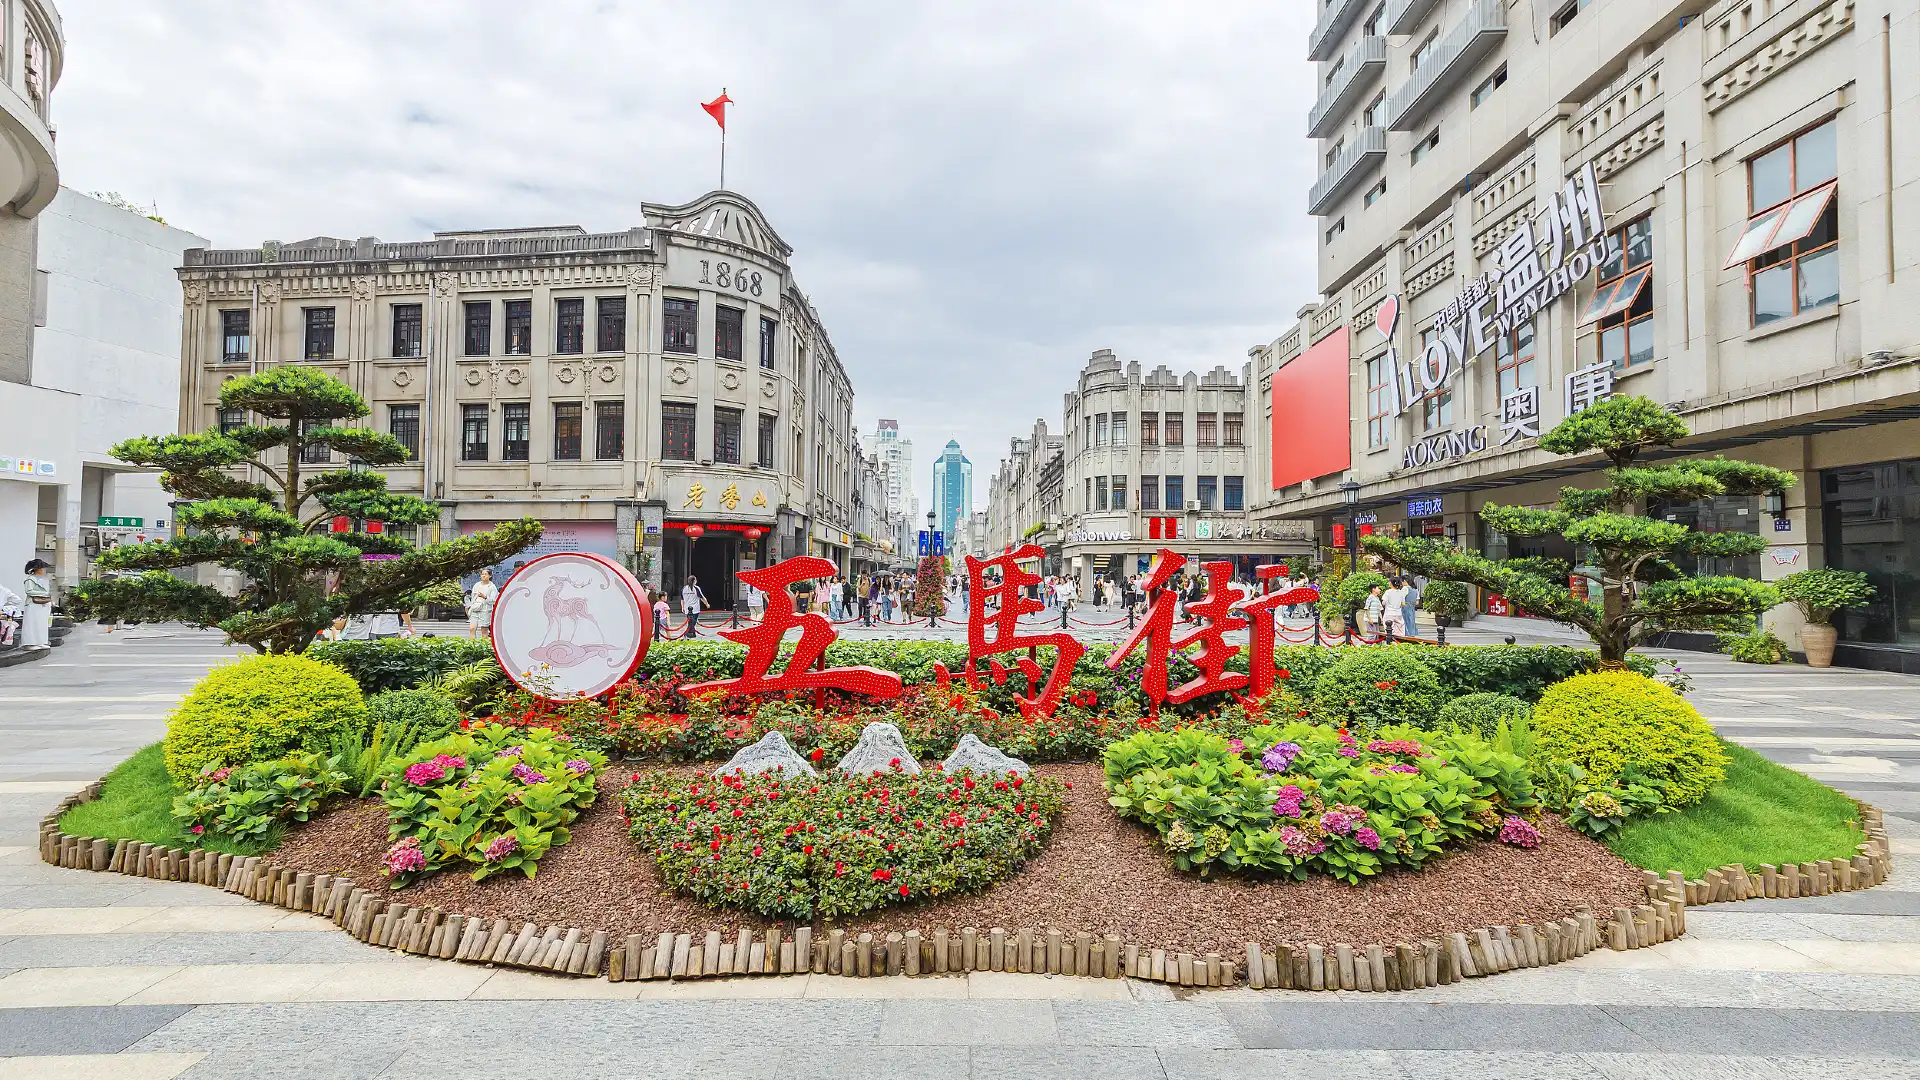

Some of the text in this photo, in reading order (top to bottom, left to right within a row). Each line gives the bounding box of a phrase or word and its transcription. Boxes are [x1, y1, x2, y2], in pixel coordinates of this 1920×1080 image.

[699, 260, 763, 297] 1868
[1492, 161, 1606, 314] 温州
[1433, 272, 1490, 332] 中国鞋都
[1496, 236, 1611, 338] WENZHOU
[1402, 294, 1499, 408] LOVE
[1500, 360, 1617, 446] 奥康
[1402, 424, 1488, 469] AOKANG
